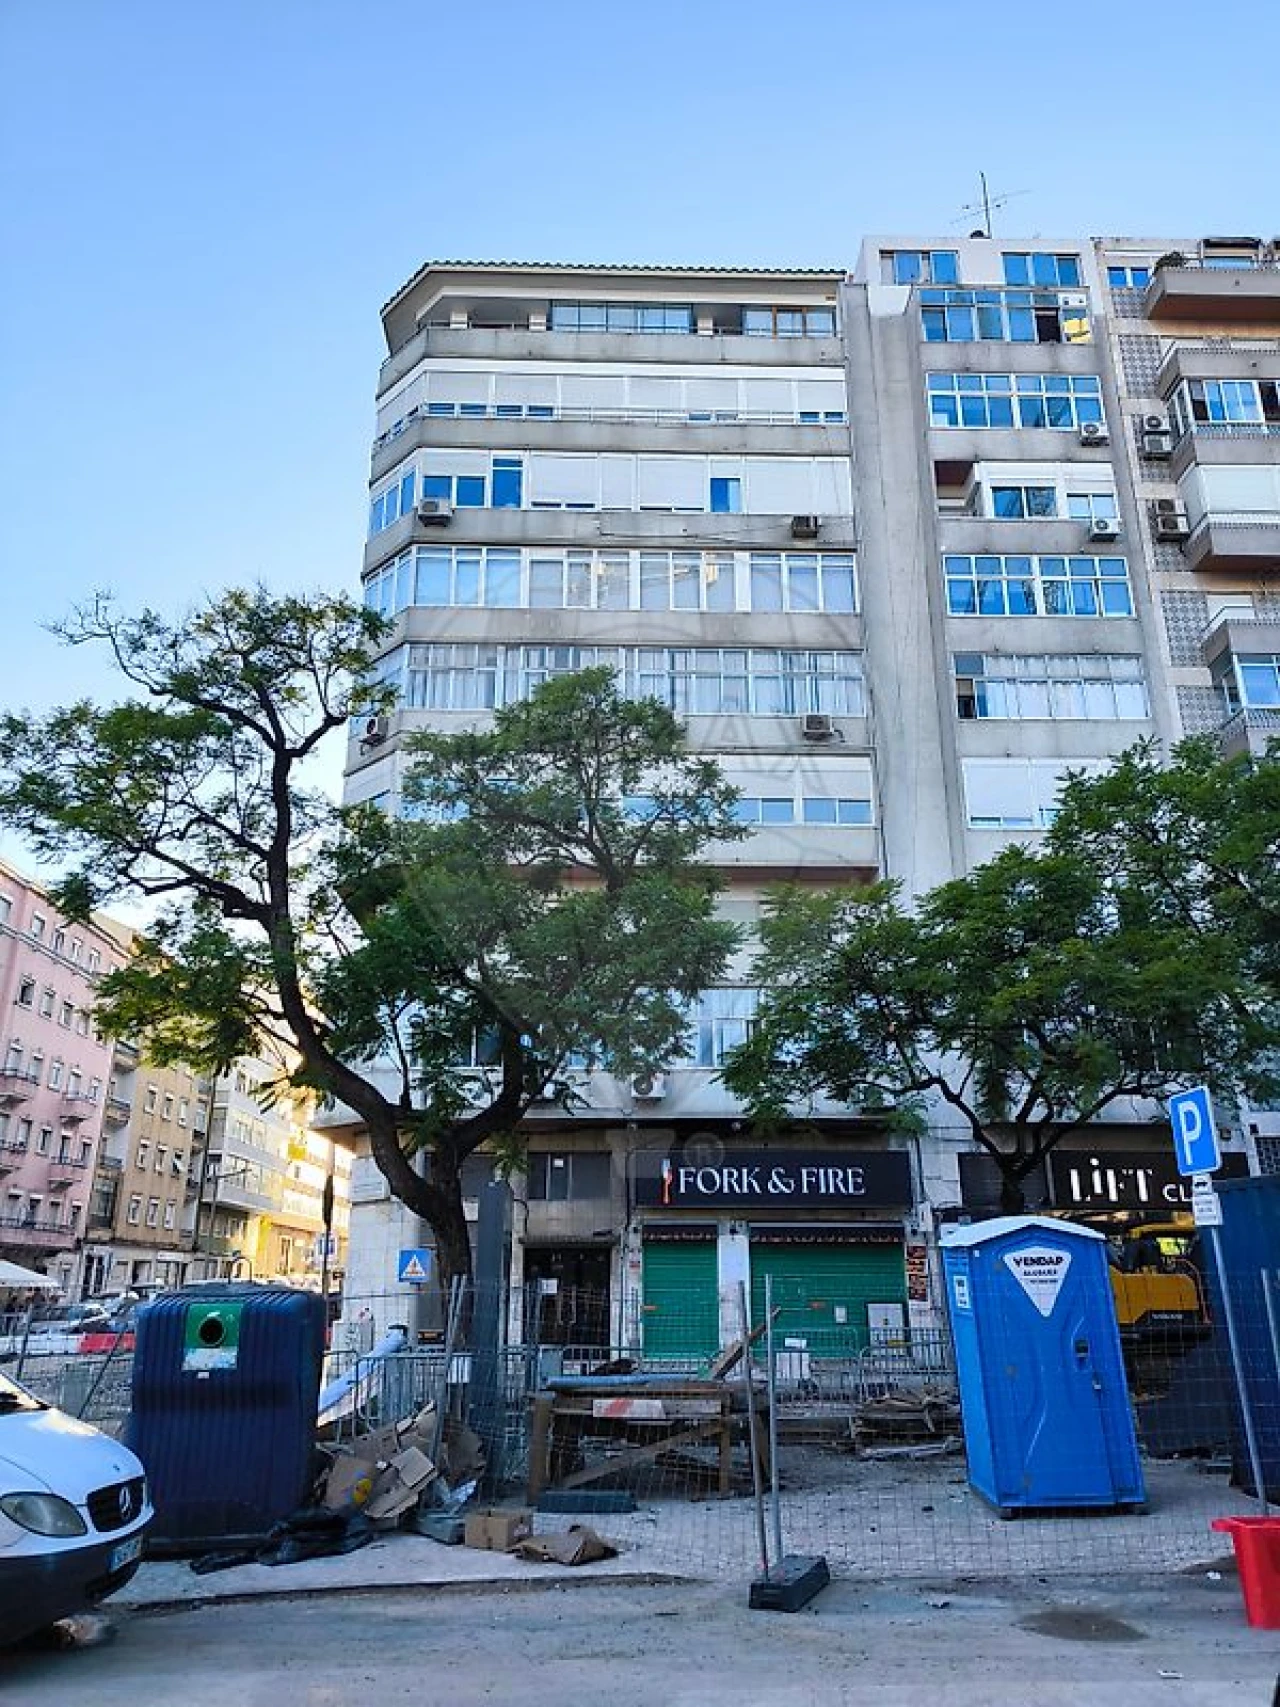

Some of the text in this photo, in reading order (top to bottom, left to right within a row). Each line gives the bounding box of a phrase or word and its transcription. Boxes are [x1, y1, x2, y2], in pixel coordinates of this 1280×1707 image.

[1177, 1100, 1204, 1166] P
[678, 1166, 866, 1195] FORK & FIRE
[1162, 1183, 1194, 1202] CL
